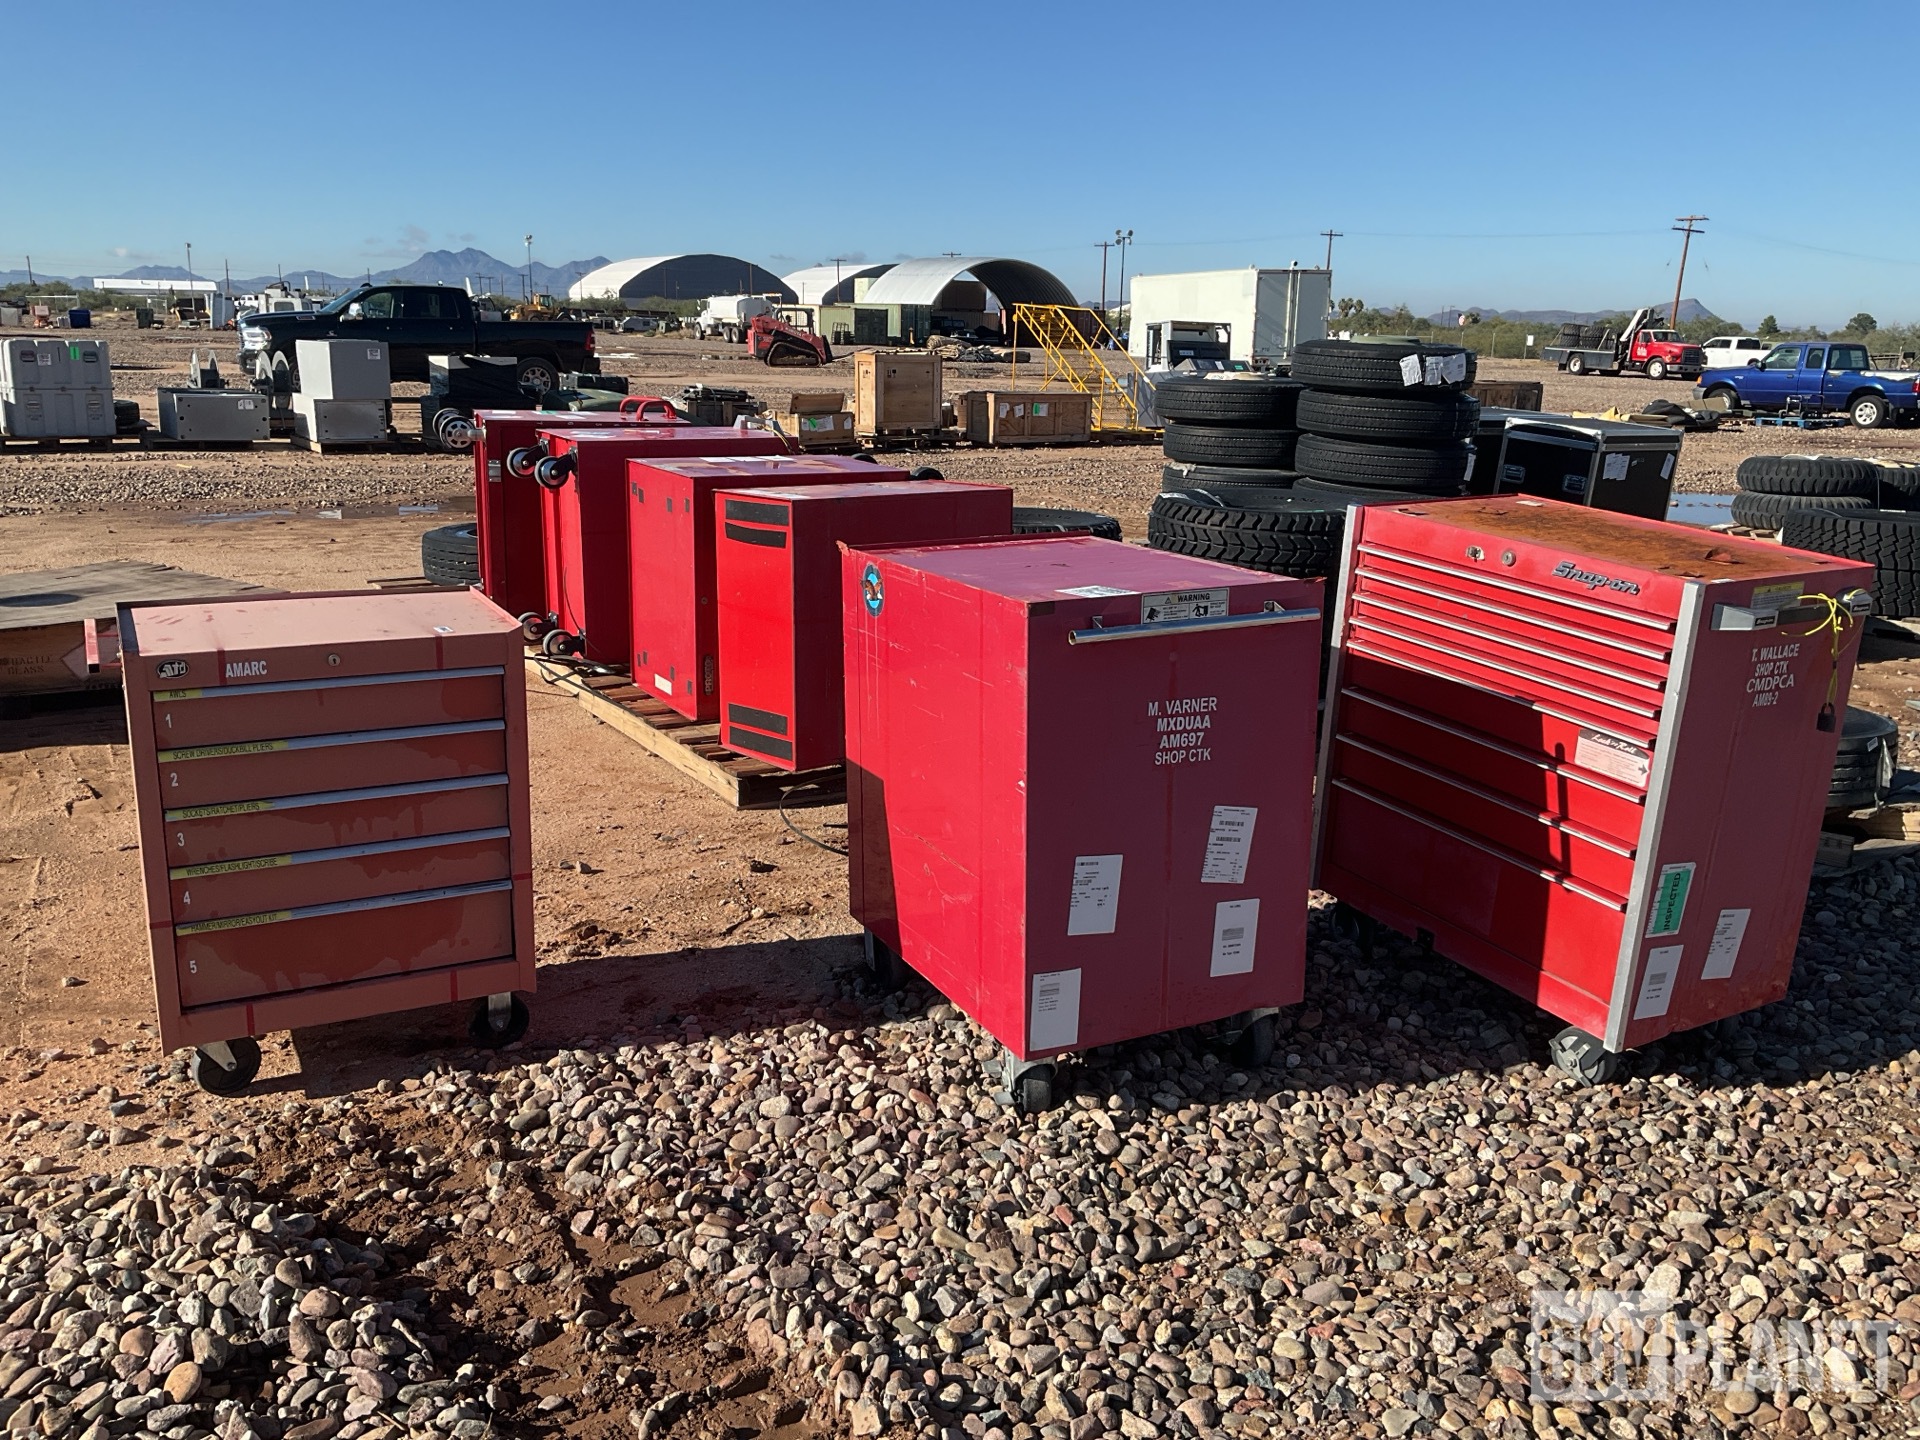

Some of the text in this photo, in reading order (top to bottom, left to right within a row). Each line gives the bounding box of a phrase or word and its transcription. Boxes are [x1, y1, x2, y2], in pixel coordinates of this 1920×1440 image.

[1552, 561, 1640, 595] Snap-on
[1177, 593, 1210, 602] WARNING
[1760, 643, 1799, 661] WALLACE
[226, 661, 267, 678] AMARC
[1755, 660, 1789, 677] SHOP CTK
[1746, 674, 1794, 692] CMDPCA
[1148, 697, 1217, 716] M. VARNER
[165, 713, 172, 728] 1
[1157, 715, 1211, 732] MXDUAA
[1160, 731, 1204, 749] AM697
[1154, 748, 1211, 766] SHOP CTK
[170, 772, 178, 787] 2
[177, 832, 185, 847] 3
[183, 891, 191, 905] 4
[1664, 873, 1681, 930] INSPECTED
[189, 960, 197, 973] 5
